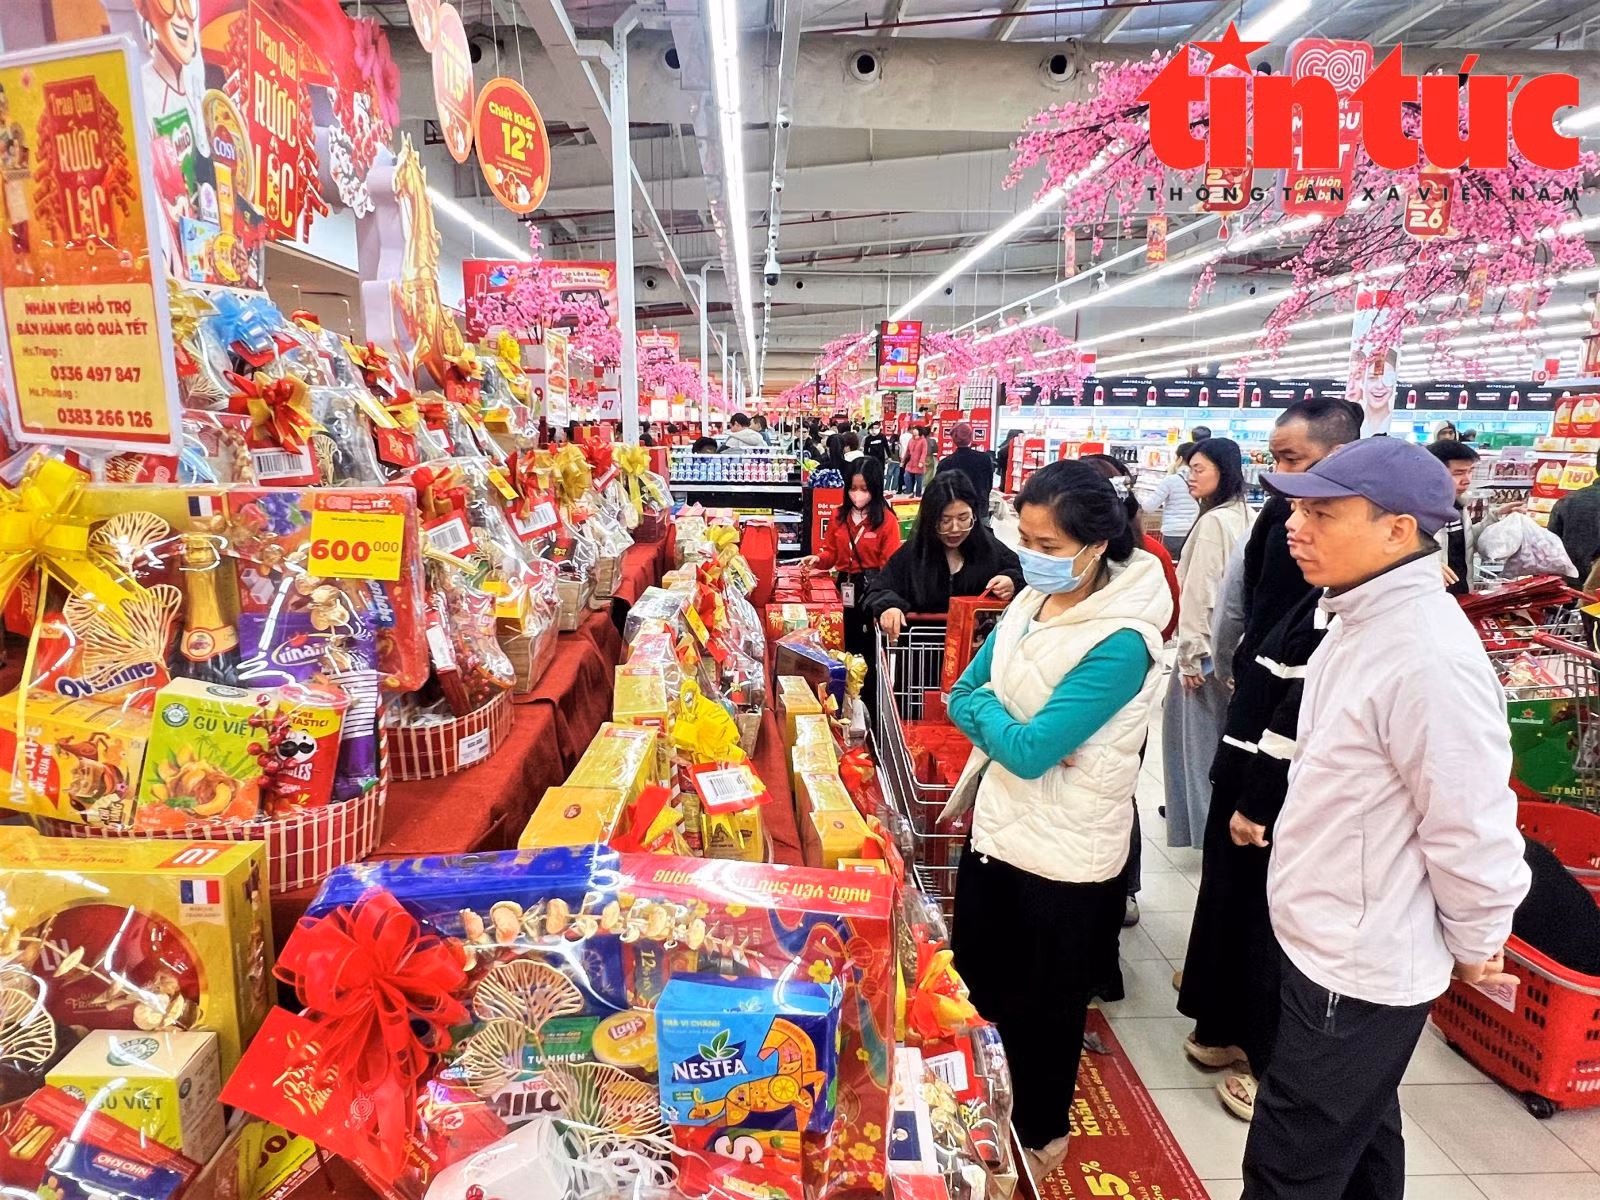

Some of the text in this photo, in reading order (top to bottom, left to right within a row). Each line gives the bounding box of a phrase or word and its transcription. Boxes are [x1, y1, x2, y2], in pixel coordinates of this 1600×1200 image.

[255, 18, 297, 81] Trao Quà
[49, 88, 95, 118] Trao Quà
[254, 69, 297, 148] RƯỚC
[488, 101, 513, 122] Chiết
[513, 112, 536, 131] Khấu
[56, 120, 102, 172] RƯỚC
[502, 122, 534, 161] 12%
[1315, 176, 1342, 187] luôn
[1410, 208, 1444, 229] 26
[25, 300, 56, 315] NHÂN
[58, 299, 85, 315] VIÊN
[107, 299, 132, 317] TRỢ
[16, 320, 40, 335] BÁN
[40, 320, 72, 335] HÀNG
[98, 318, 123, 335] QUÀ
[125, 317, 148, 335] TẾT
[51, 366, 141, 382] 0336 497 847
[601, 401, 614, 411] 47
[57, 408, 153, 428] 0383 266 126
[193, 715, 218, 732] GU
[290, 716, 330, 728] TASTIC!
[172, 847, 219, 865] LU
[672, 1058, 749, 1081] NESTEA
[123, 1095, 164, 1115] VIỆT
[1072, 1098, 1103, 1136] Khấu
